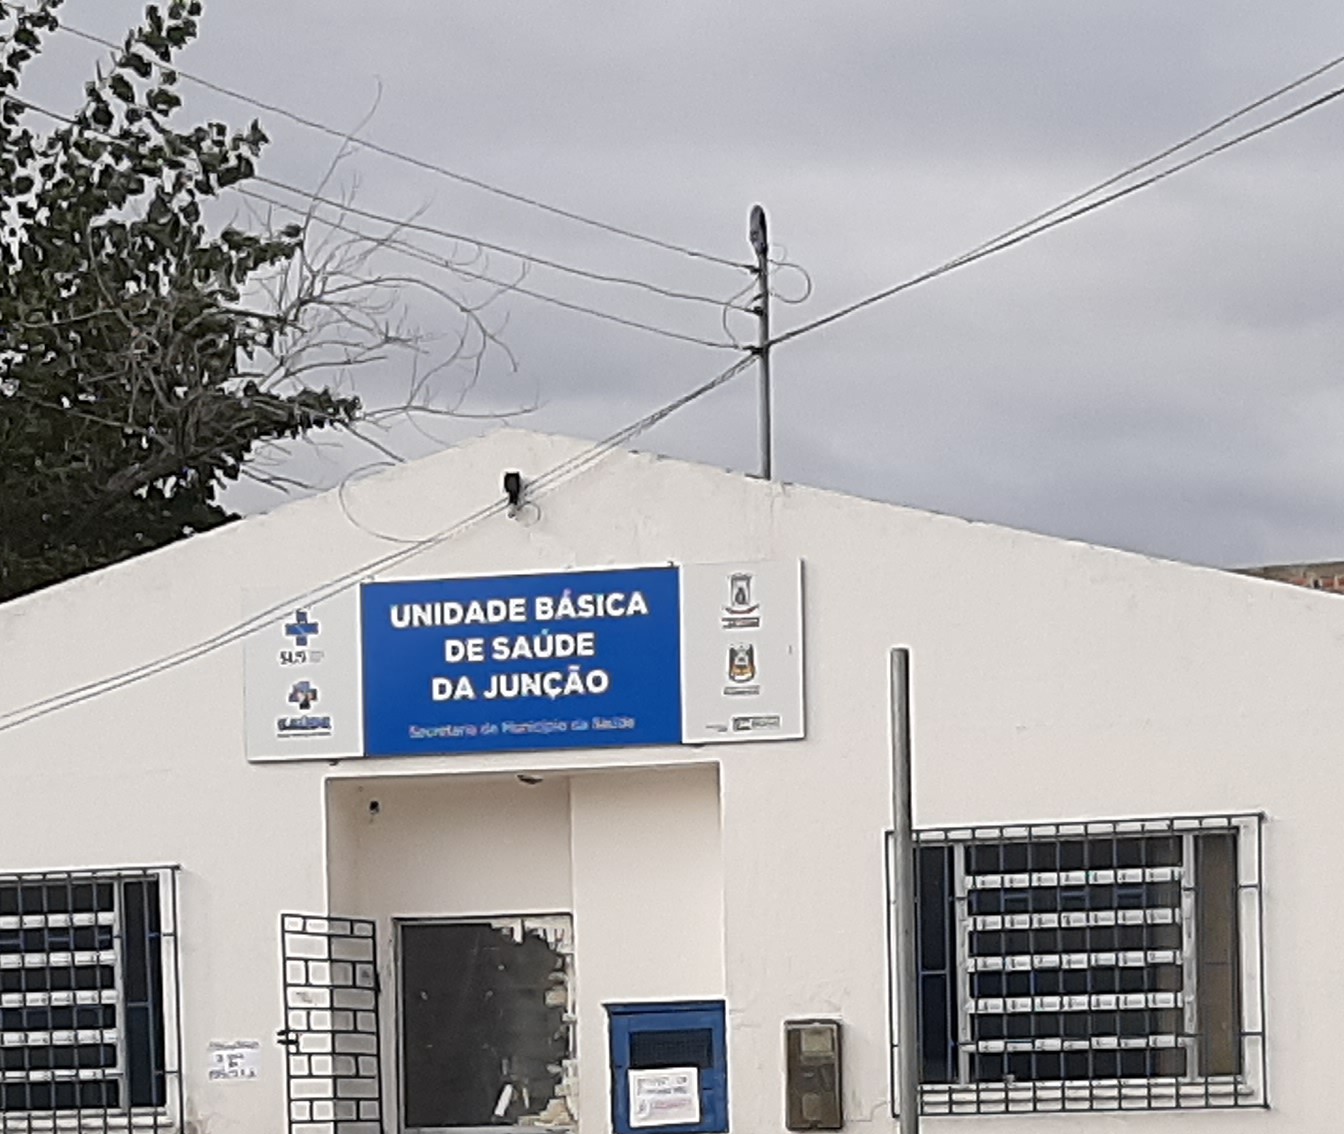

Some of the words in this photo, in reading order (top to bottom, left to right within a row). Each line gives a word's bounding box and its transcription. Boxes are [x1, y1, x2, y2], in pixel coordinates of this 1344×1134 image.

[390, 599, 527, 628] UNIDADE
[535, 588, 648, 620] BÁSICA
[444, 638, 484, 662] DE
[492, 628, 594, 660] SAÚDE
[432, 676, 475, 701] DA
[483, 665, 609, 700] JUNÇÃO
